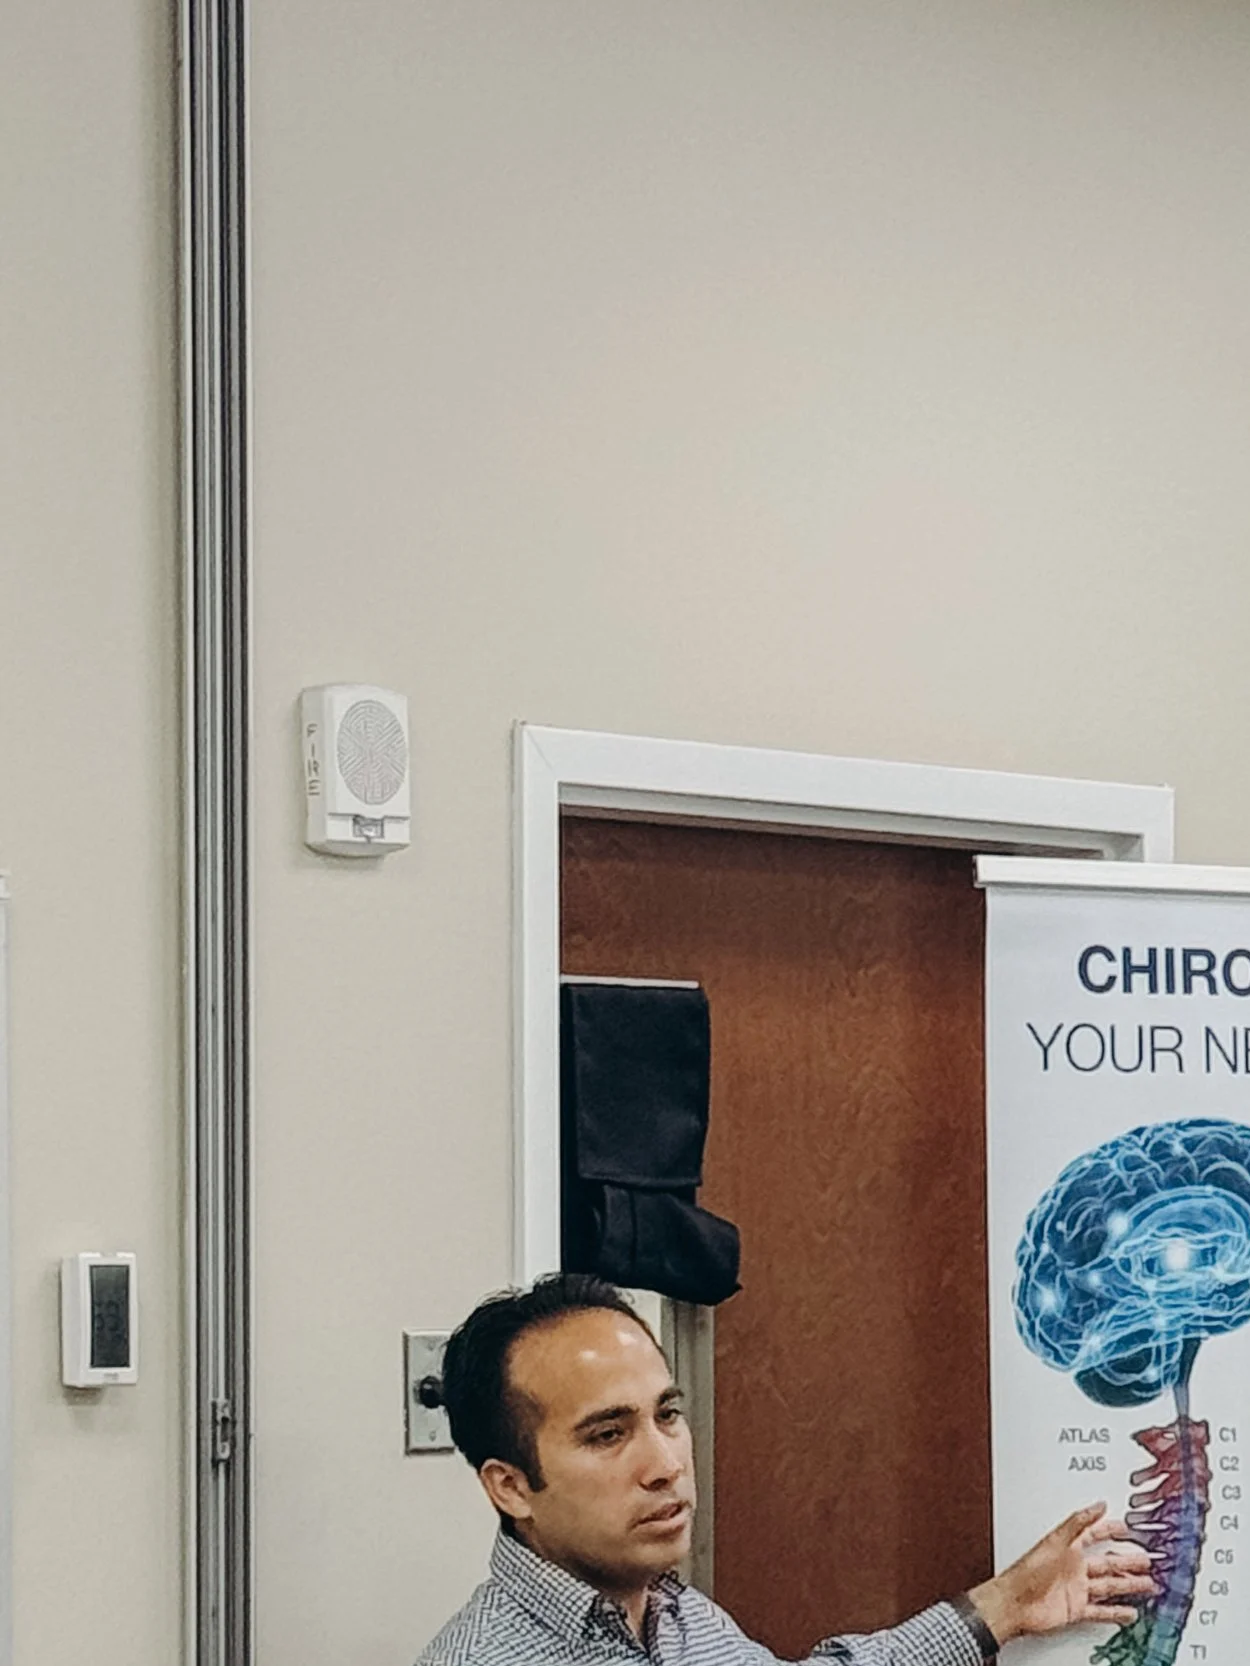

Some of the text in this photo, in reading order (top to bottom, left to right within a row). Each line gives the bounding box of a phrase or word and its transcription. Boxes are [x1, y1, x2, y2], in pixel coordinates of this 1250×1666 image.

[307, 723, 321, 796] FIRE
[1026, 1022, 1184, 1074] YOUR
[1058, 1428, 1111, 1444] ATLAS
[1219, 1427, 1237, 1443] C1
[1068, 1457, 1107, 1471] AXIS
[1219, 1457, 1240, 1472] C2
[1222, 1485, 1242, 1500] C3
[1220, 1515, 1239, 1531] C4
[1214, 1550, 1234, 1565] C5
[1209, 1581, 1229, 1596] C6
[1199, 1610, 1218, 1626] C7
[1190, 1645, 1207, 1660] T1
